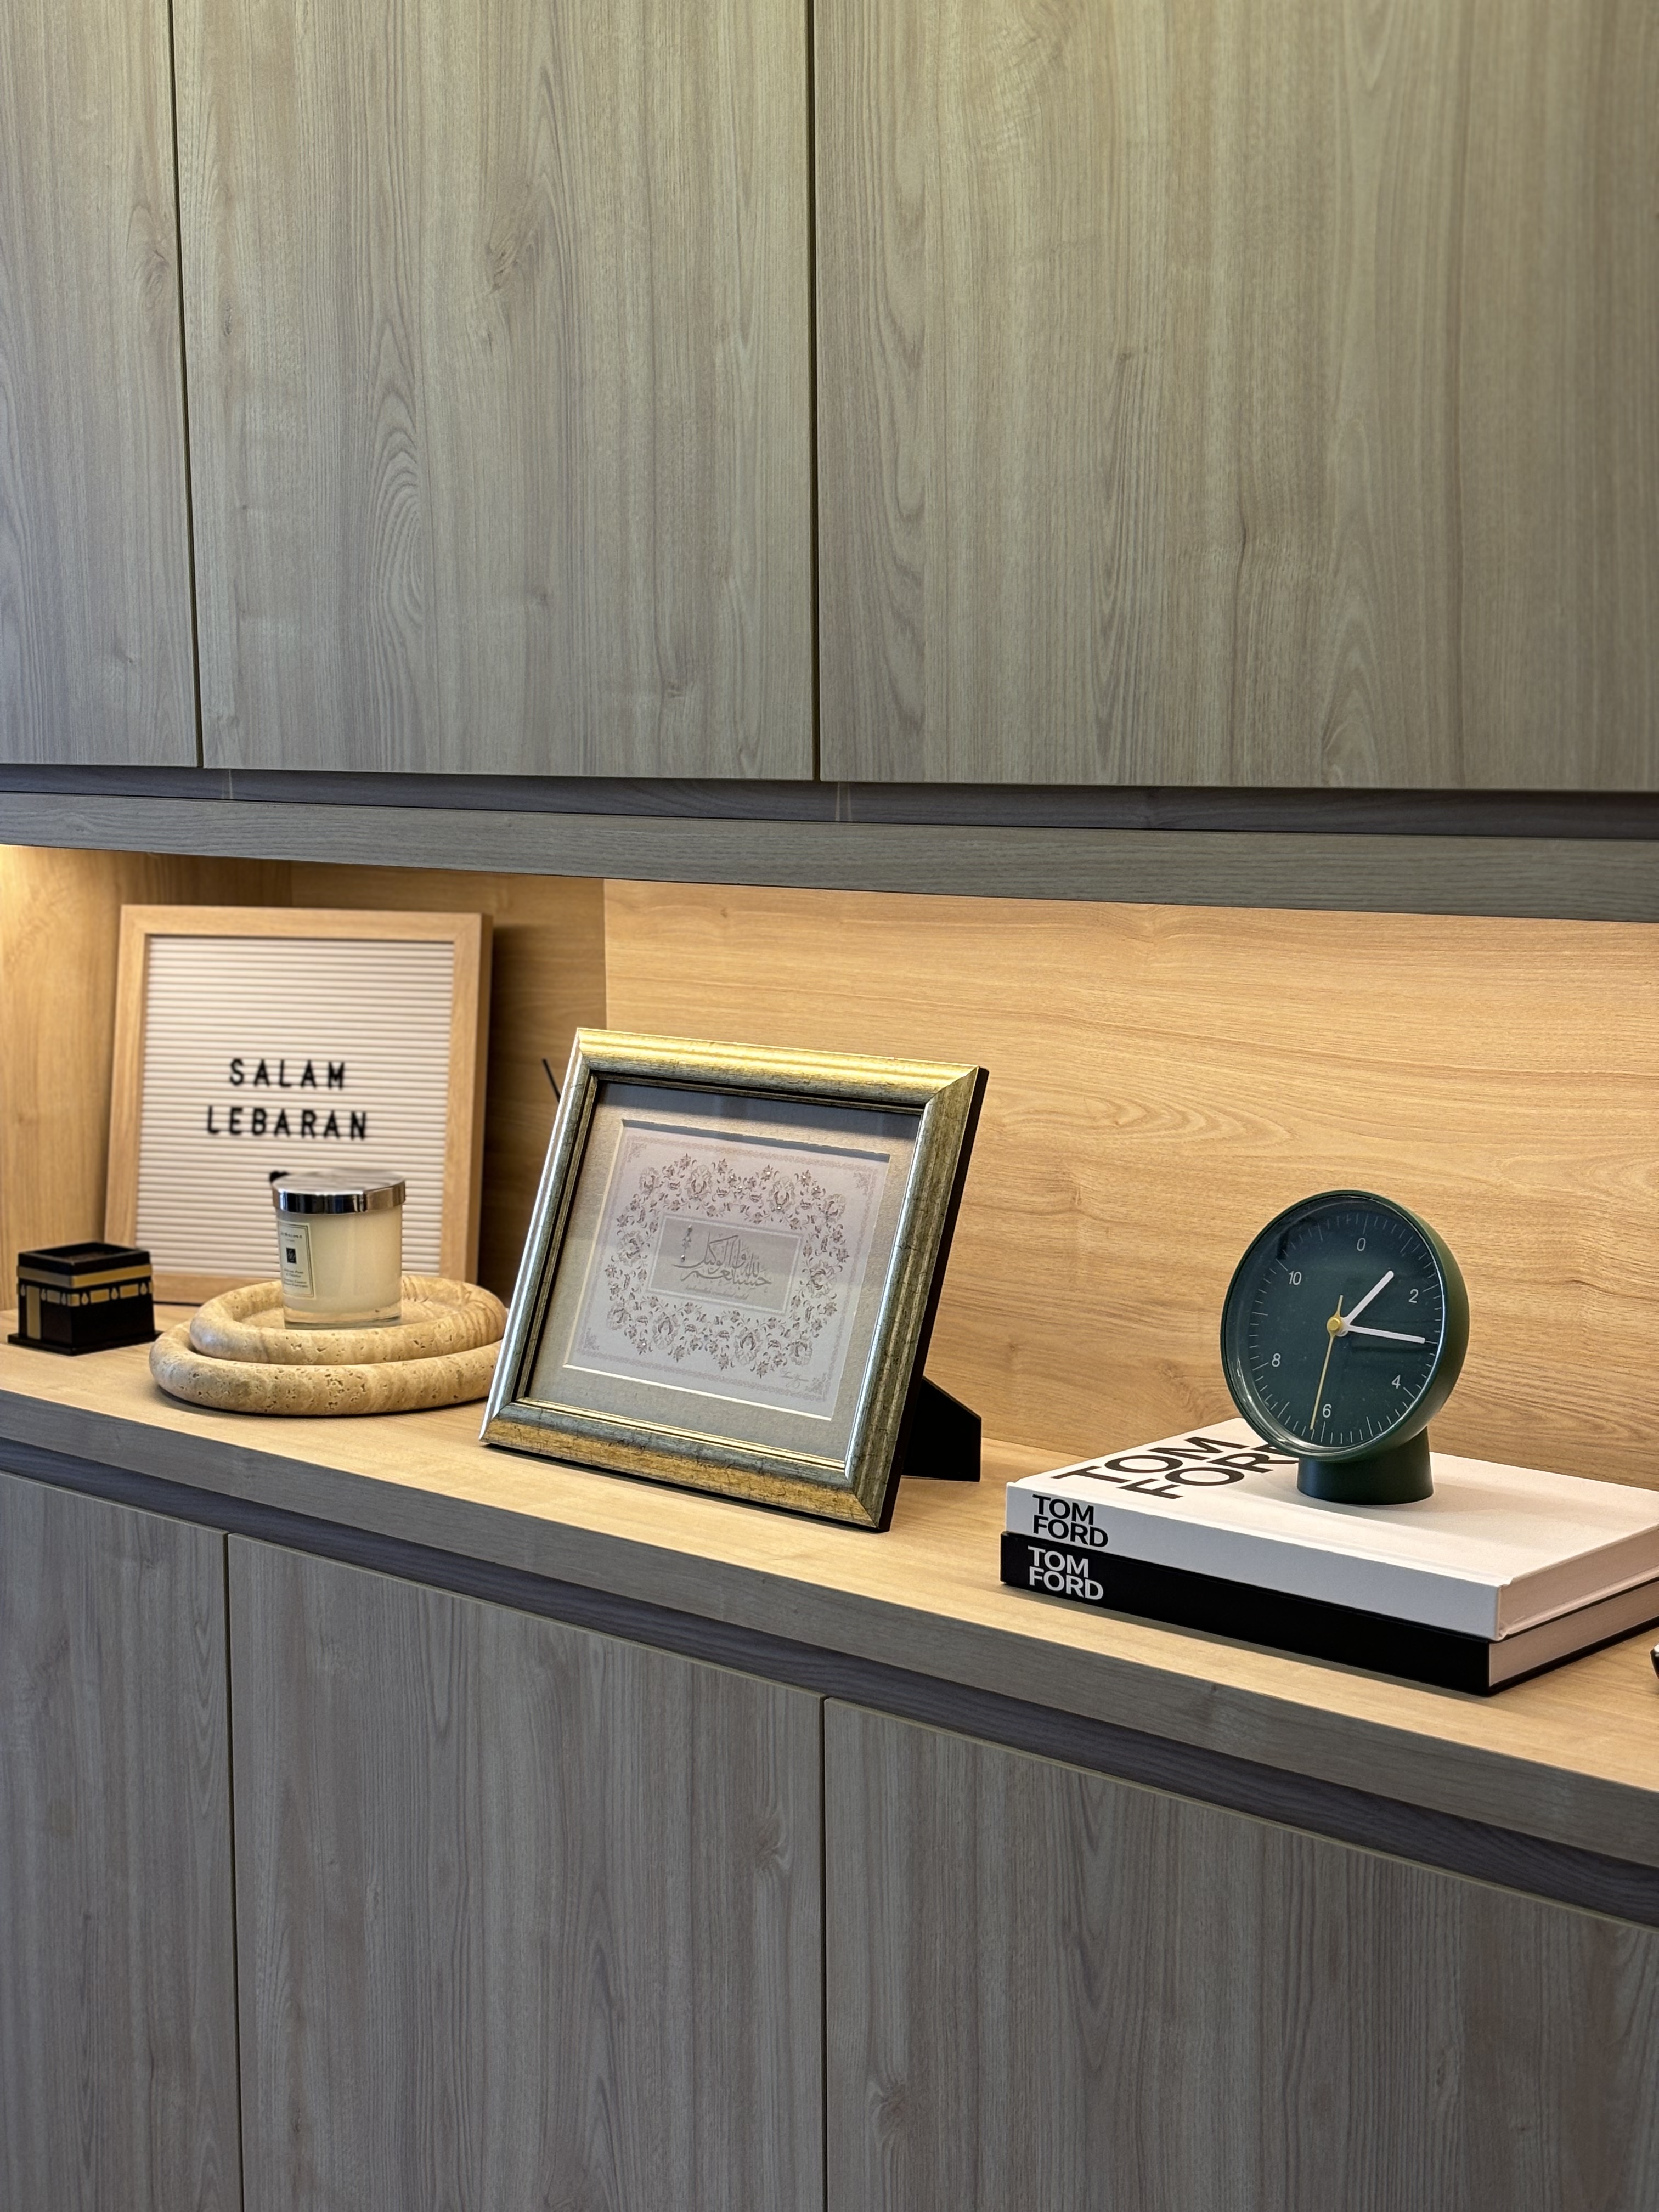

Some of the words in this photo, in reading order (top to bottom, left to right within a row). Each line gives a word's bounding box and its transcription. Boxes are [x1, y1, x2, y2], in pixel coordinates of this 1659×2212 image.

[229, 1058, 345, 1090] SALAM
[207, 1105, 366, 1141] LEBARAN
[1357, 1238, 1366, 1251] 0
[1288, 1271, 1302, 1285] 10
[1408, 1289, 1419, 1304] 2
[1271, 1353, 1281, 1367] 8
[1391, 1374, 1401, 1389] 4
[1322, 1403, 1332, 1418] 6
[1050, 1436, 1250, 1483] TOM
[1032, 1494, 1094, 1525] TOM
[1033, 1515, 1108, 1548] FORD
[1028, 1545, 1088, 1578] TOM
[1029, 1566, 1104, 1600] FORD
